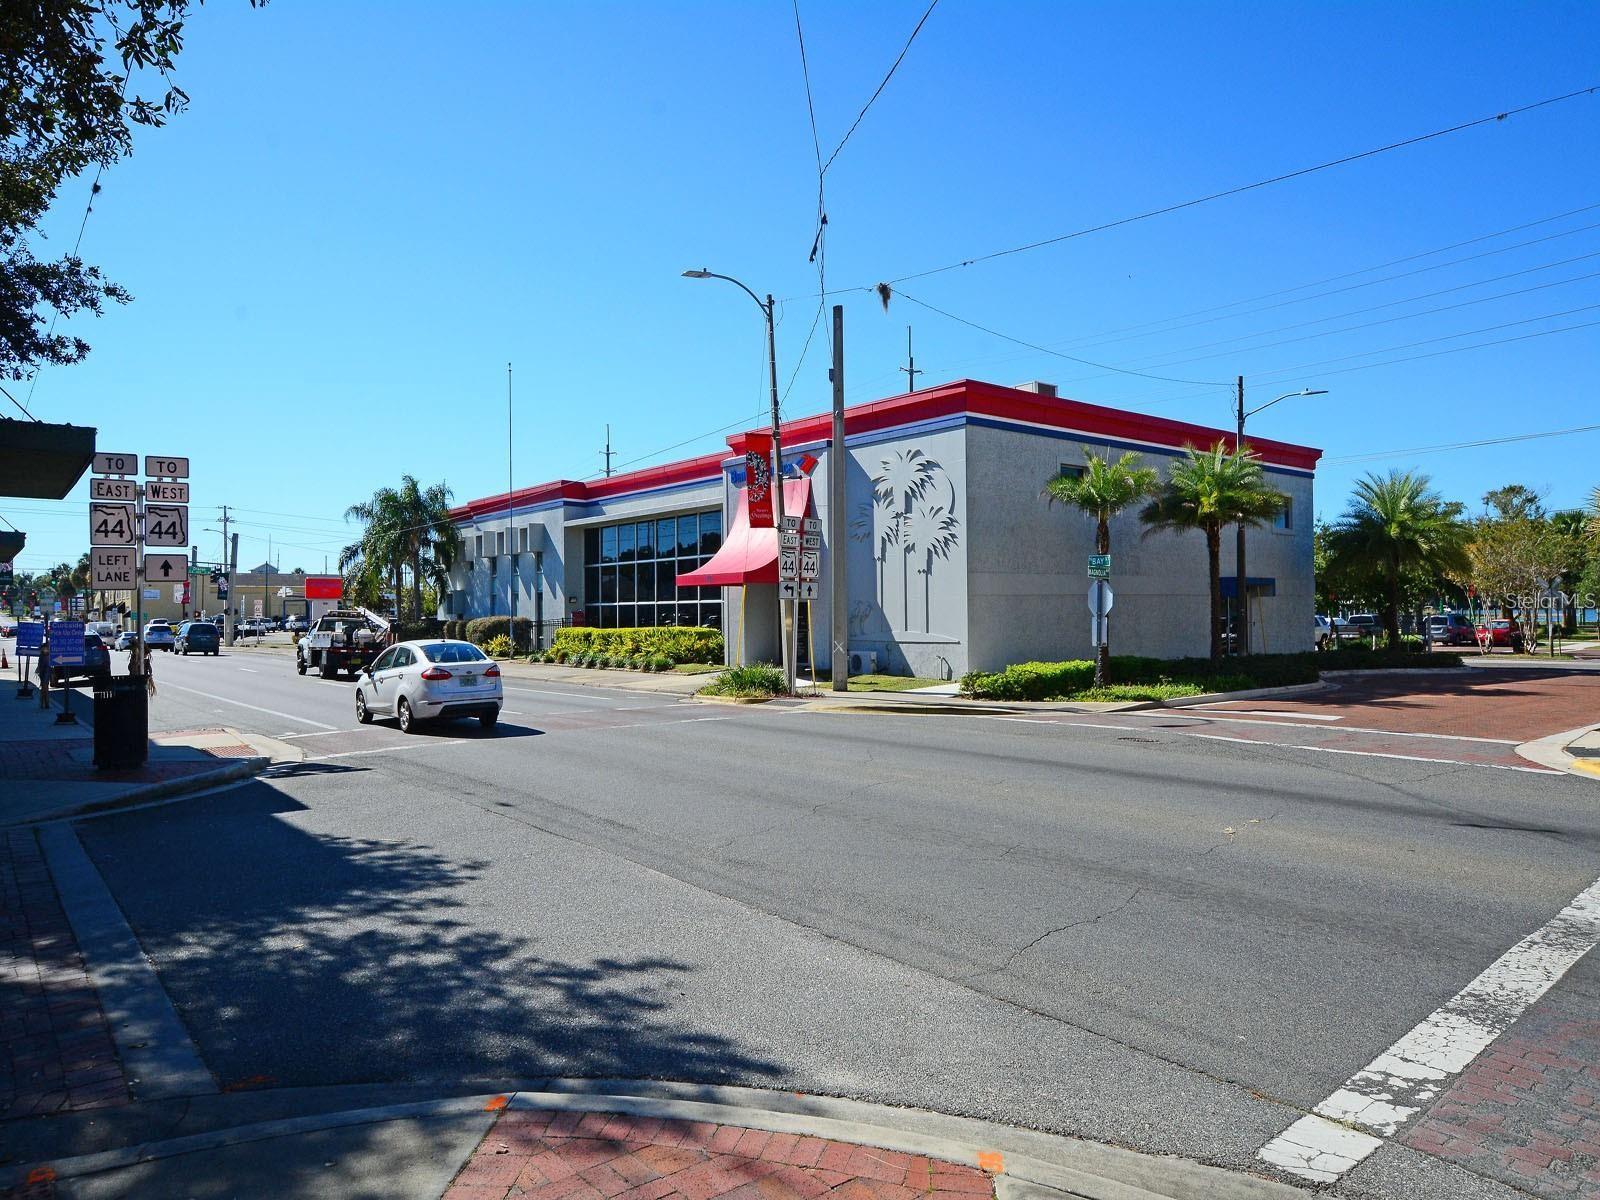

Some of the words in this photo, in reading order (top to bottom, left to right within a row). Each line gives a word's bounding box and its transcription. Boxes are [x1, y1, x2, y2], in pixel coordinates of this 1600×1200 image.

[105, 457, 125, 470] TO
[156, 461, 178, 474] TO
[97, 482, 130, 498] EAST
[150, 485, 184, 499] WEST
[94, 518, 125, 538] 44
[786, 519, 796, 527] TO
[809, 521, 817, 530] TO
[149, 520, 178, 540] 44
[783, 535, 797, 545] EAST
[805, 537, 819, 546] WEST
[98, 555, 129, 566] LEFT
[1092, 557, 1104, 565] BAY
[782, 560, 795, 573] 44
[803, 561, 816, 573] 44
[97, 571, 130, 582] LANE
[1089, 569, 1106, 577] MAGNOLIA
